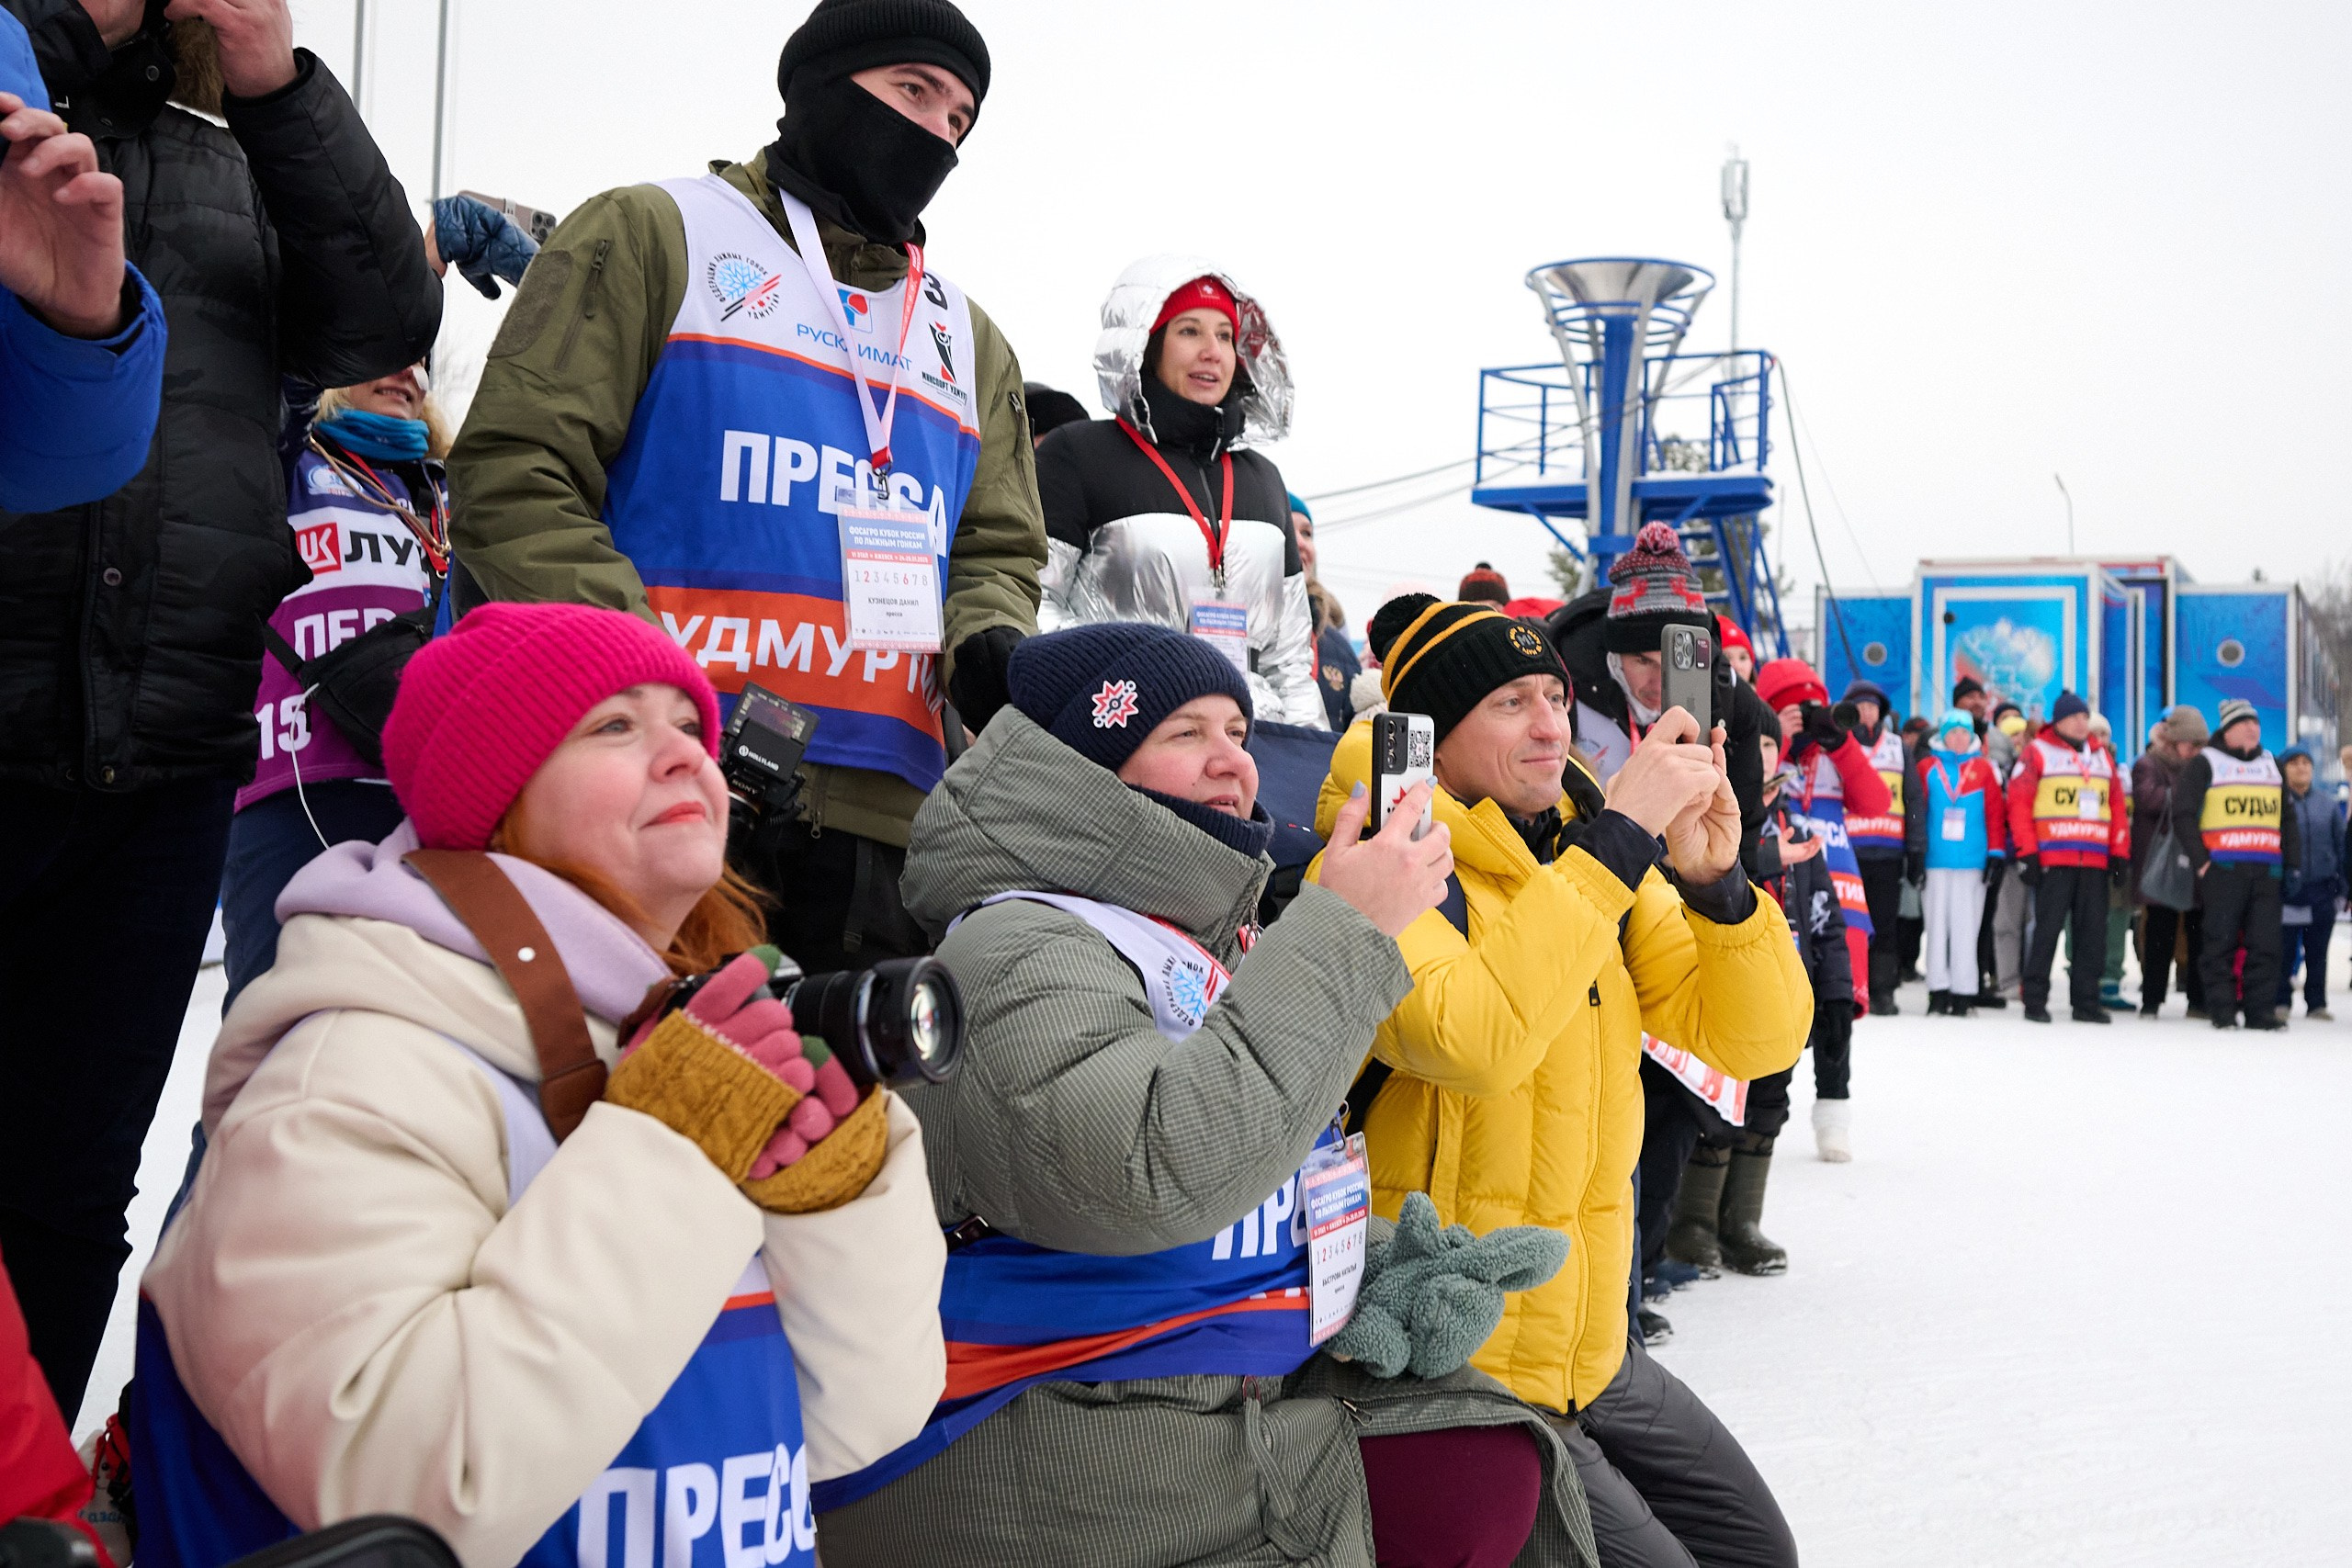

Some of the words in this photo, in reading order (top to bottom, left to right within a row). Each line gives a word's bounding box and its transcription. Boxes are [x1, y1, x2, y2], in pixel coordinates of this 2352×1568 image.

[746, 257, 768, 276] ГОНОК
[797, 323, 912, 371] РУСКИМАТ
[720, 429, 947, 558] ПРЕССА
[849, 526, 878, 536] ФОСАГРО
[879, 528, 900, 538] КУБОК
[900, 531, 926, 540] РОССИИ
[854, 536, 864, 545] ПО
[865, 536, 896, 548] ЛЫЖНЫМ
[897, 540, 923, 550] ГОНКАМ
[855, 570, 861, 582] 1
[864, 570, 870, 582] 2
[874, 571, 879, 583] 3
[884, 572, 889, 584] 4
[893, 572, 899, 584] 5
[903, 573, 909, 587] 6
[912, 574, 918, 586] 7
[922, 574, 928, 586] 8
[868, 597, 898, 605] КУЗНЕЦОВ
[254, 694, 311, 761] 15
[748, 750, 780, 772] HOLLYLAND
[1182, 960, 1204, 974] НОК
